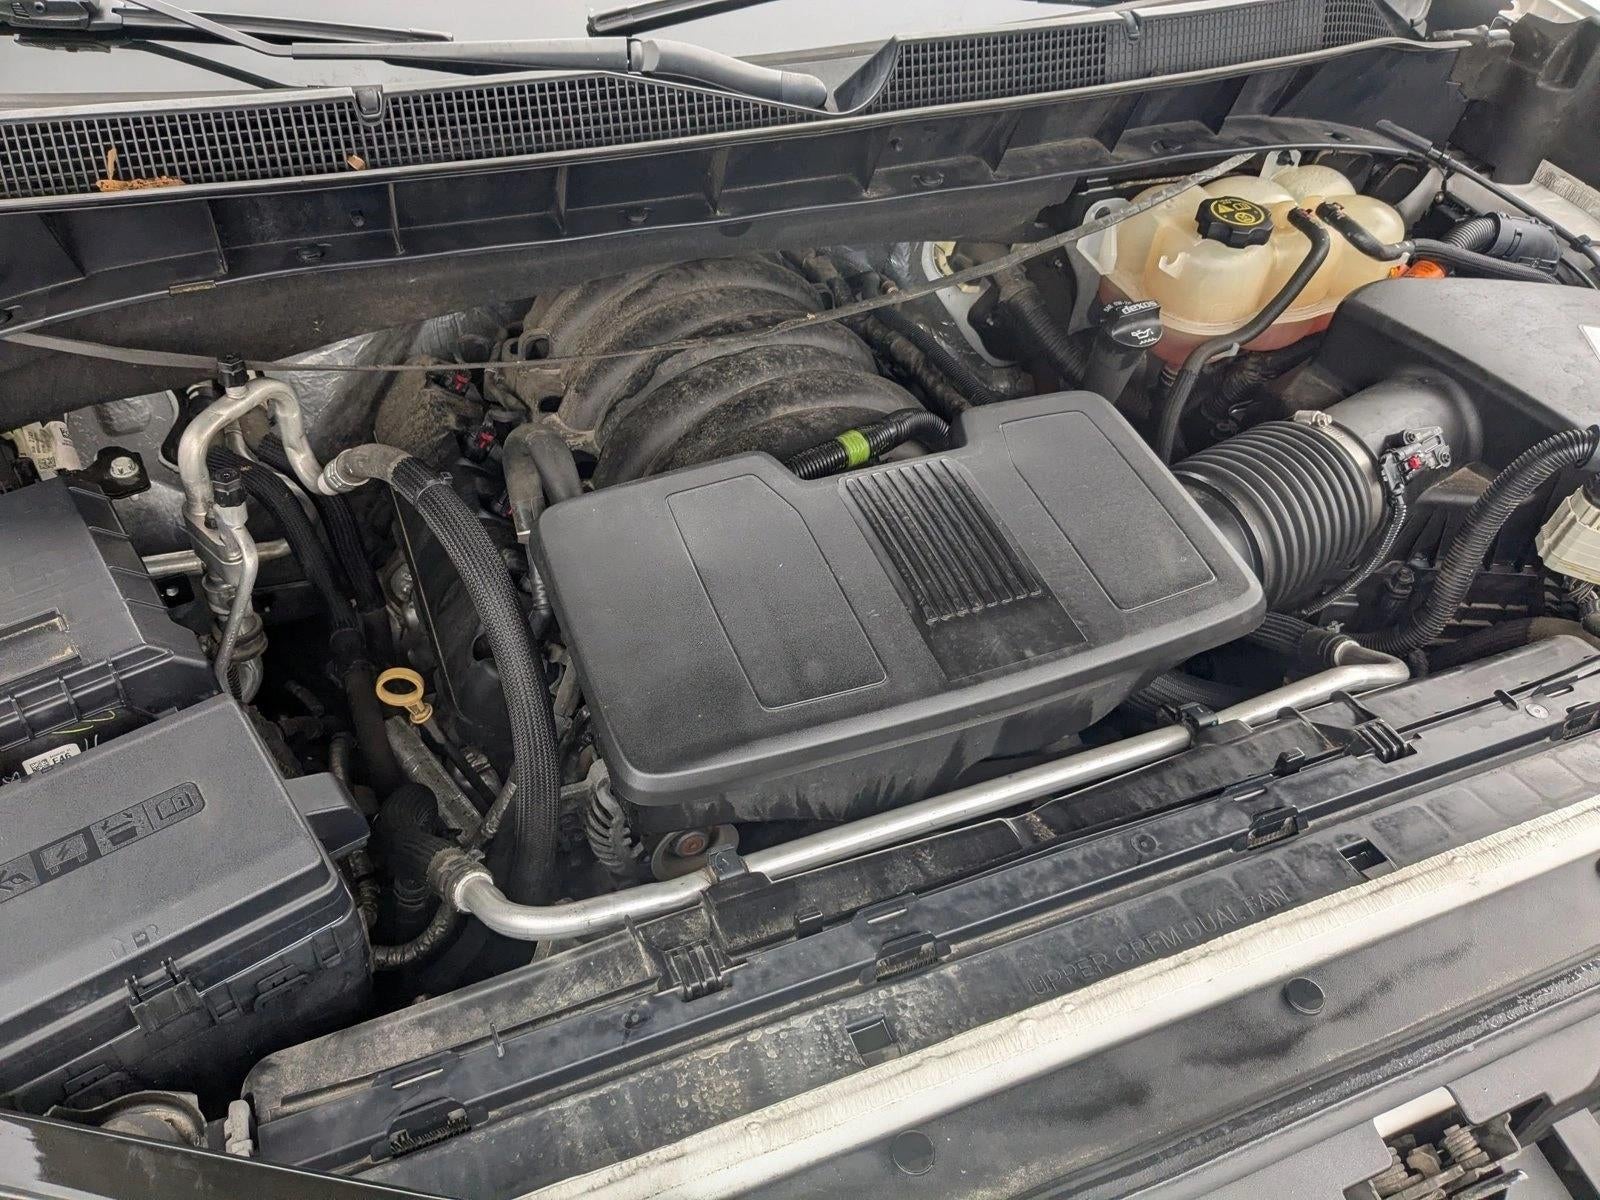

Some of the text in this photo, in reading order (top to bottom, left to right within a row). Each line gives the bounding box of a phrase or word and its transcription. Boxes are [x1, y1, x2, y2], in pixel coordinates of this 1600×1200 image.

[1122, 300, 1158, 314] dexos
[1027, 953, 1112, 995] UPPER
[1182, 905, 1246, 940] DUAL
[1246, 884, 1291, 917] FAN
